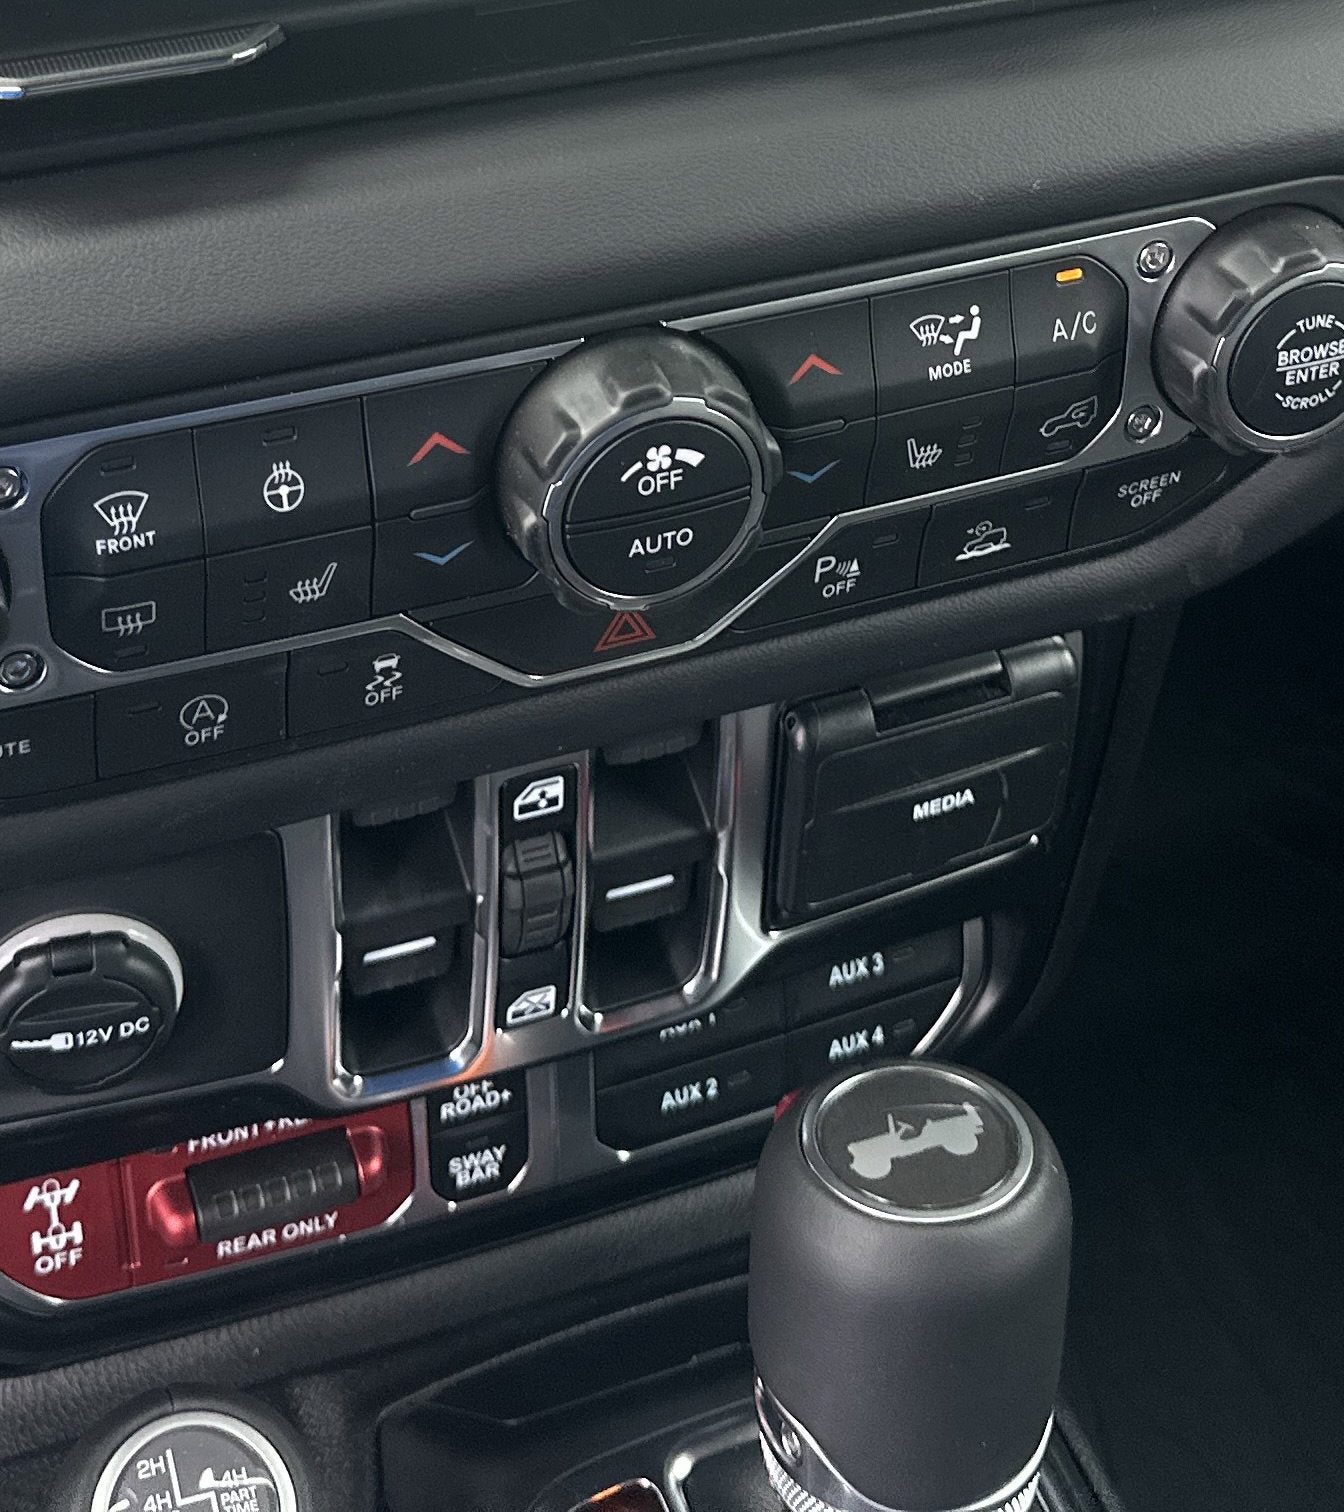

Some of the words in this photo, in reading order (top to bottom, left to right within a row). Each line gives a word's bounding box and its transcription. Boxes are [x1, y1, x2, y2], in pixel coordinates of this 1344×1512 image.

[1052, 310, 1099, 343] A/C
[1295, 313, 1336, 334] TUNE
[927, 358, 973, 381] MODE
[1284, 361, 1340, 386] ENTER
[1280, 388, 1337, 410] SCROLL
[637, 469, 684, 494] OFF
[1117, 470, 1182, 500] SCREEN
[1130, 489, 1162, 509] OFF
[94, 530, 157, 556] FRONT
[627, 525, 694, 559] AUTO
[822, 578, 858, 599] OFF
[364, 684, 404, 707] OFF
[184, 724, 226, 747] OFF
[912, 788, 975, 822] MEDIA
[828, 955, 869, 988] AUX
[871, 951, 886, 977] 3
[75, 1025, 113, 1049] 12V
[117, 1015, 151, 1040] DC
[828, 1028, 870, 1063] AUX
[871, 1024, 886, 1047] 4
[660, 1080, 704, 1115] AUX
[705, 1076, 720, 1101] 2
[447, 1143, 507, 1176] SWAY
[454, 1162, 502, 1189] BAR
[216, 1226, 278, 1259] REAR
[281, 1210, 340, 1240] ONLY
[32, 1246, 84, 1277] OFF
[136, 1454, 167, 1481] 2H
[219, 1486, 258, 1508] PART
